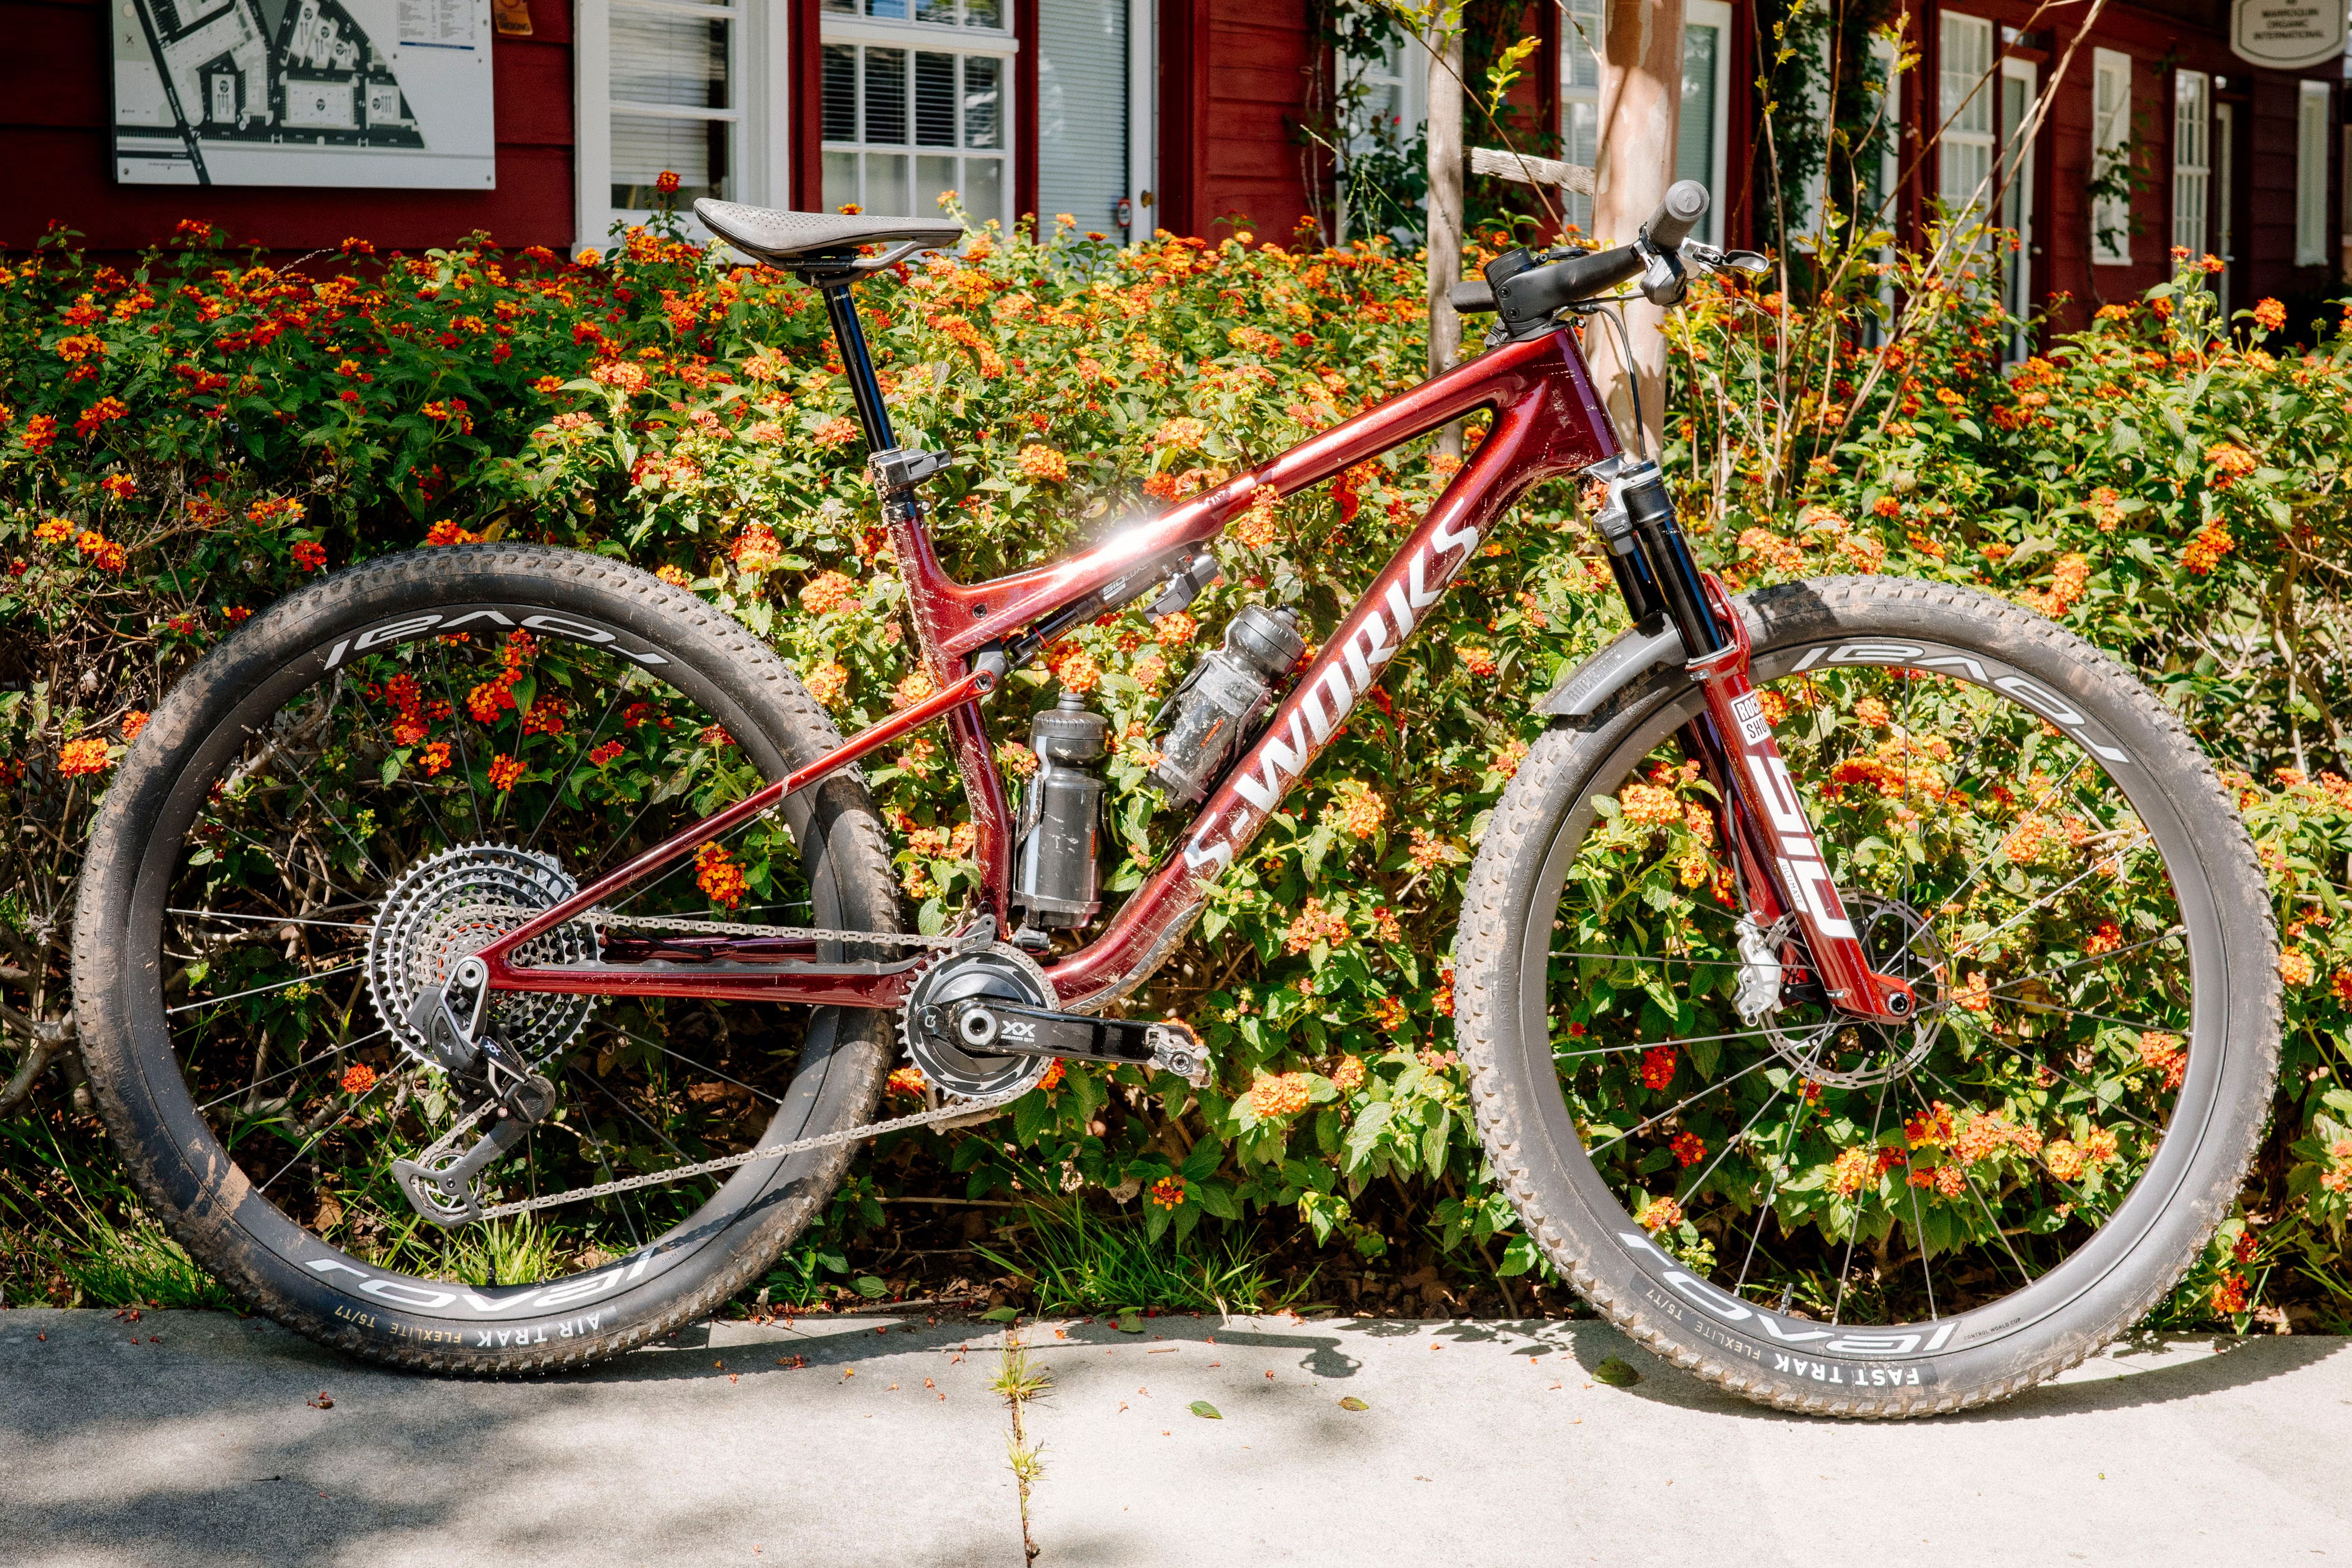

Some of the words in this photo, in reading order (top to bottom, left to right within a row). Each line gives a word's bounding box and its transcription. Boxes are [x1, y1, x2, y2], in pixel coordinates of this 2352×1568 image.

[2253, 30, 2325, 40] INTERNATIONAL
[1184, 498, 1478, 870] S-WORKS
[1500, 958, 1512, 993] TRAK
[1517, 867, 1530, 901] TUBELESS
[1527, 849, 1539, 869] READY
[1535, 816, 1554, 847] PRESSURE
[1559, 790, 1568, 804] PSI
[1582, 756, 1593, 769] BAR
[1611, 723, 1623, 737] KPA
[1627, 697, 1654, 718] ROTATION
[1782, 864, 1803, 904] ULTIMATE
[106, 899, 116, 933] PRESSURE
[1002, 1020, 1036, 1037] XX
[334, 1305, 376, 1328] T5/T7
[389, 1322, 463, 1344] FLEXLITE
[477, 1329, 548, 1347] TRAK
[559, 1313, 601, 1338] AIR
[1646, 1288, 1683, 1322] T5/T7
[1694, 1319, 1761, 1361] FLEXLITE
[1964, 1330, 1989, 1341] CONTROL
[1990, 1323, 2009, 1333] WORLD
[1773, 1352, 1843, 1384] TRAK
[1854, 1367, 1920, 1387] FAST
